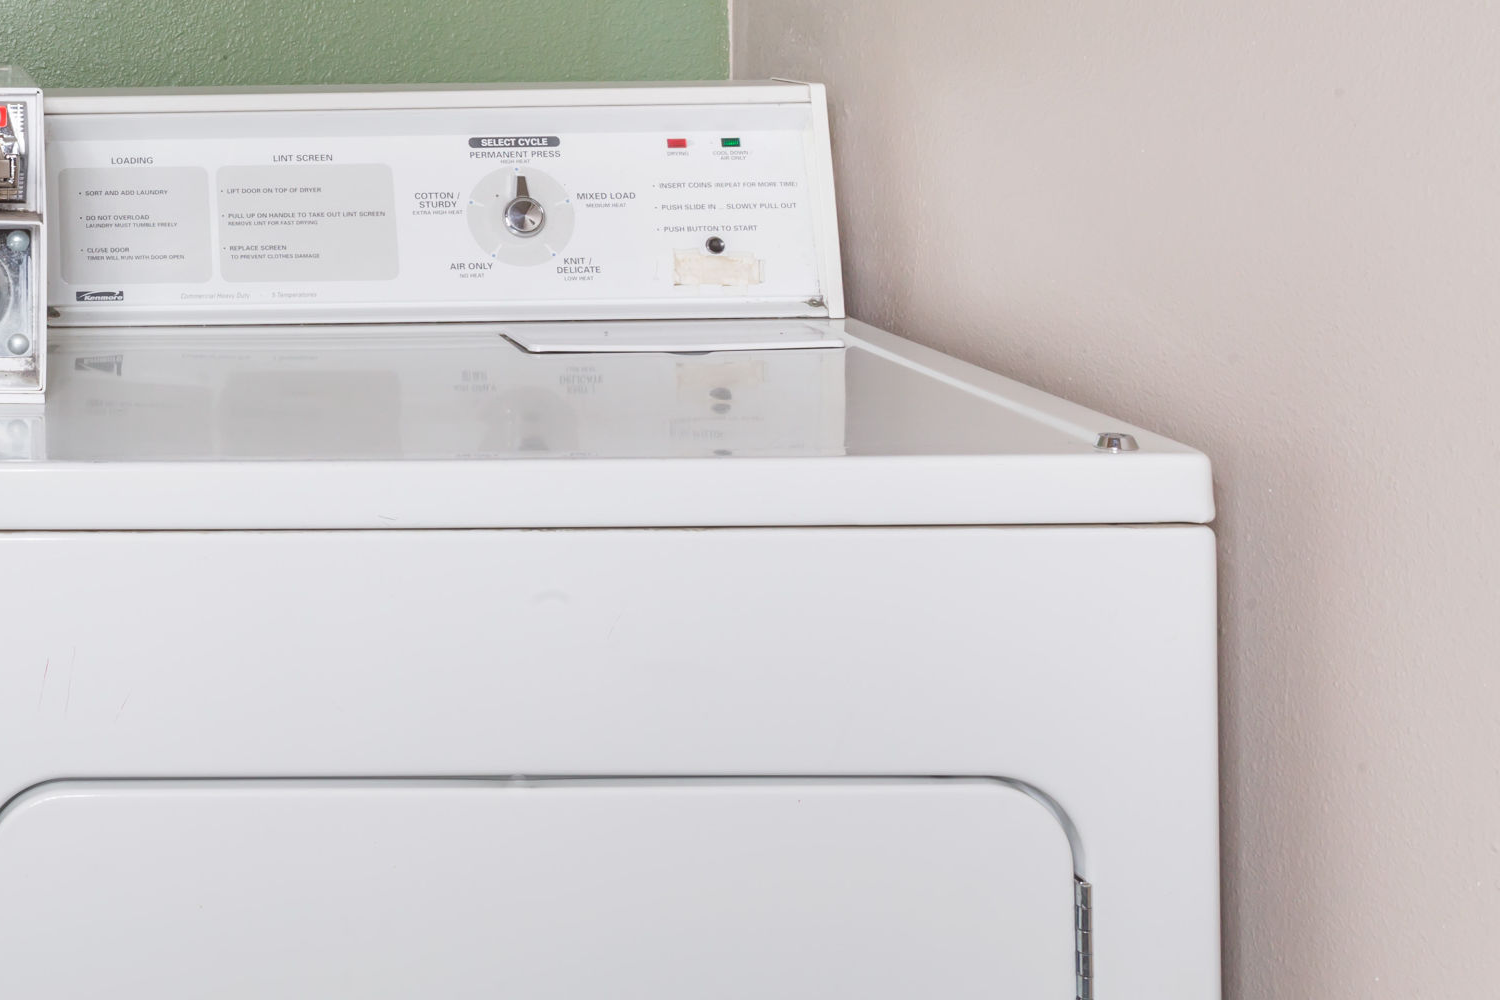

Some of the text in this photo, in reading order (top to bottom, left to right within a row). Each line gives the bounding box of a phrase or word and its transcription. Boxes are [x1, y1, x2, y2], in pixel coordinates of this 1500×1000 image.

[480, 137, 548, 147] SELECT CYCLE
[273, 154, 333, 162] LINT SCREEN
[469, 150, 561, 159] PERMANENT PRESS
[576, 192, 608, 200] MIXED
[419, 200, 457, 208] STURDY
[563, 257, 586, 265] KNIT
[450, 262, 493, 270] AIR ONLY
[556, 266, 601, 274] DELICATE
